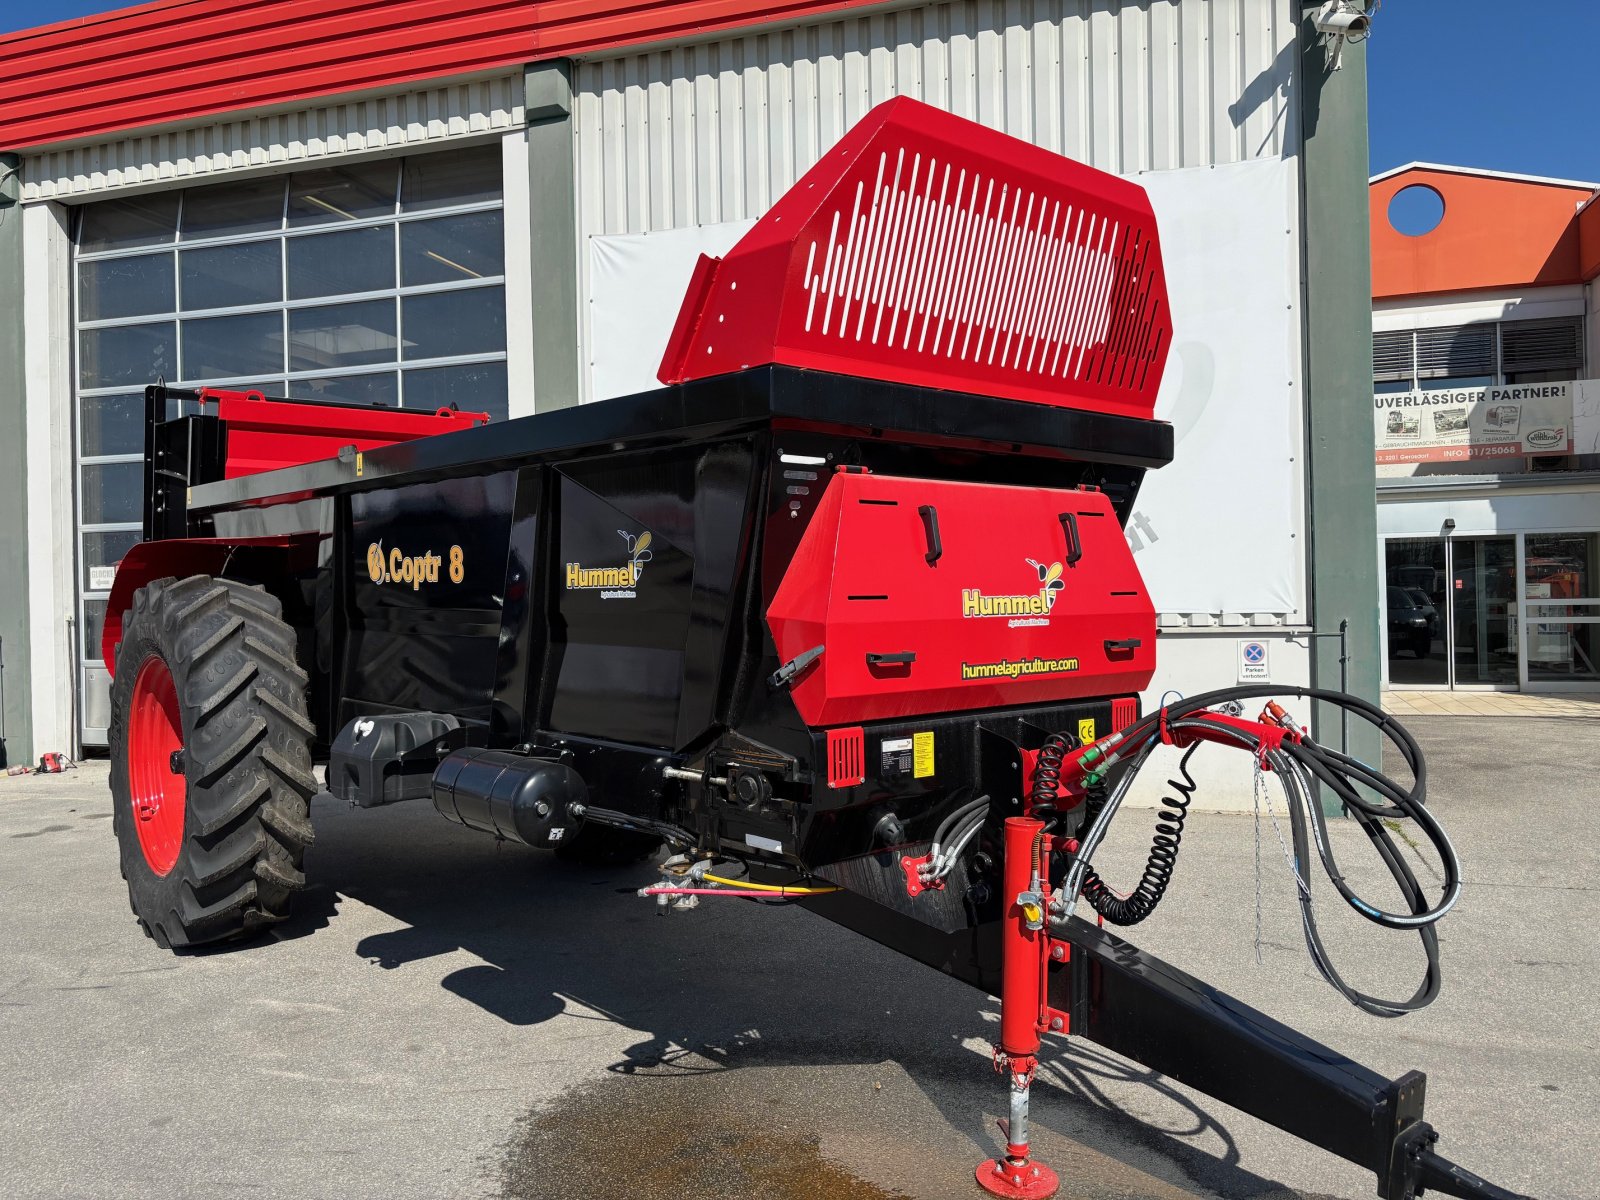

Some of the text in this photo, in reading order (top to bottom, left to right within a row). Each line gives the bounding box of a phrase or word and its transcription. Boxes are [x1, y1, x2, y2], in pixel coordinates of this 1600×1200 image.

[1375, 386, 1566, 409] UVERLÄSSIGER PARTNER!
[1467, 446, 1516, 457] 01/25068
[449, 544, 465, 584] 8
[566, 560, 637, 589] Hummel
[962, 588, 1050, 618] Hummel
[962, 658, 1079, 679] hummelagriculture.com
